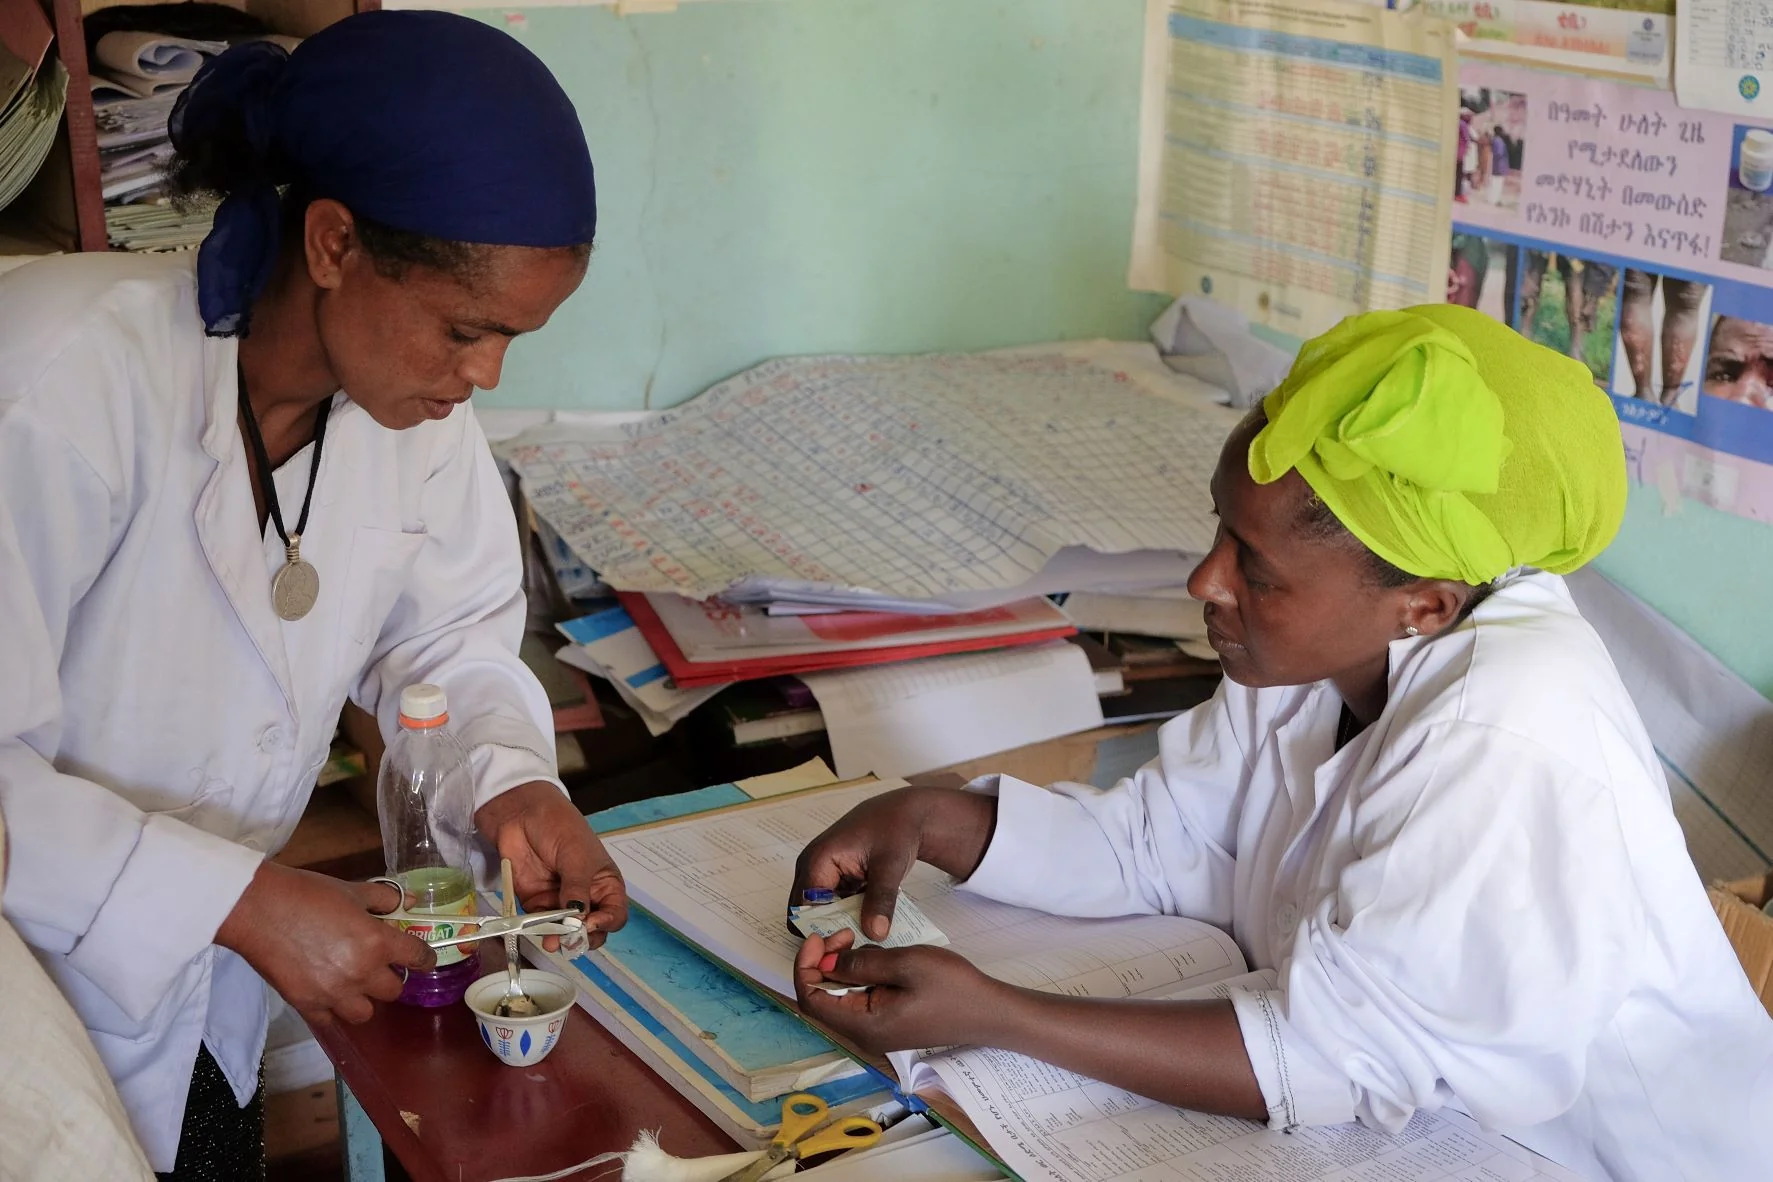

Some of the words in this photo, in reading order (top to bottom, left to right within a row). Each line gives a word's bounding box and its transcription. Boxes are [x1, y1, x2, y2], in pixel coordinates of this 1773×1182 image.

[1548, 101, 1607, 128] በዓመት
[1619, 111, 1667, 137] ሁለት
[1678, 120, 1705, 144] ጊዜ
[1621, 185, 1708, 219] በመውሰድ
